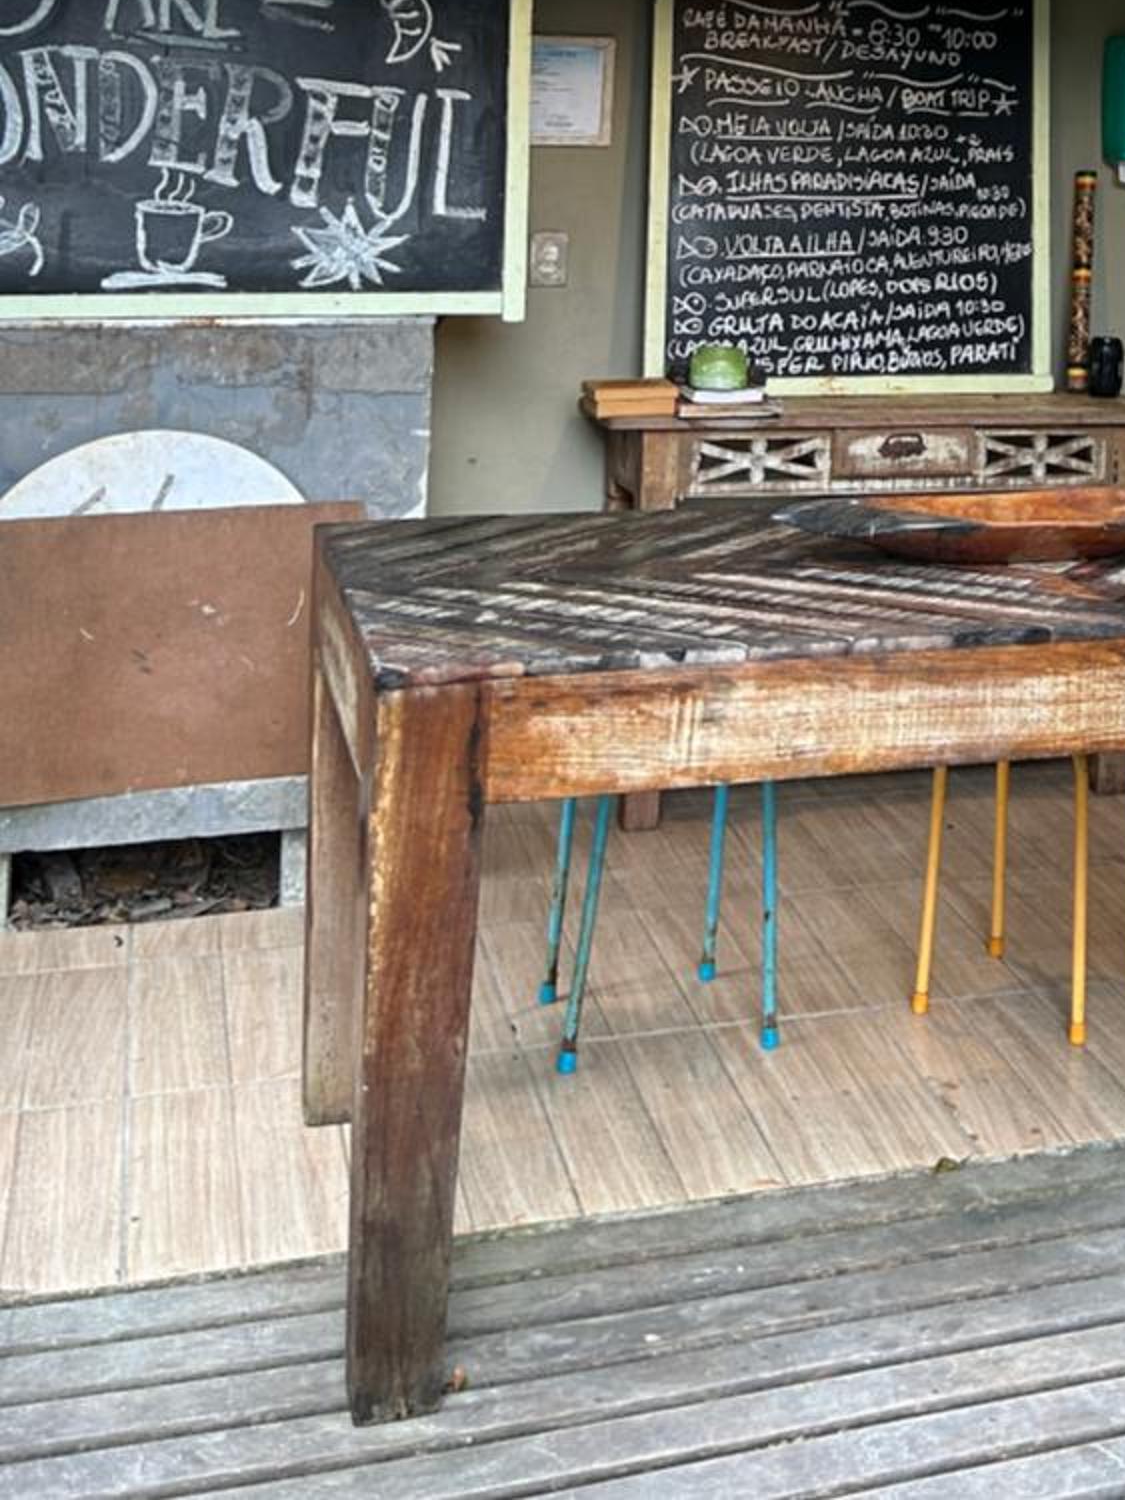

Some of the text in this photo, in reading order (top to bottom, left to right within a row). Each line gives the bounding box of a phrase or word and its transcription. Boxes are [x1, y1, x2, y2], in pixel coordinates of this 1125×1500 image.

[683, 3, 727, 29] CAFÉ
[868, 18, 921, 48] 8:30
[941, 27, 998, 50] 10:00
[705, 67, 801, 96] PASSEIO
[715, 111, 770, 136] MEIA
[775, 114, 832, 136] VOLTA
[844, 146, 906, 164] LAGOA
[725, 169, 788, 194] ILHAS
[724, 233, 786, 257] VOLTA
[807, 229, 853, 253] ILHA
[708, 312, 785, 336] GRUTA
[907, 322, 961, 342] LAGOA
